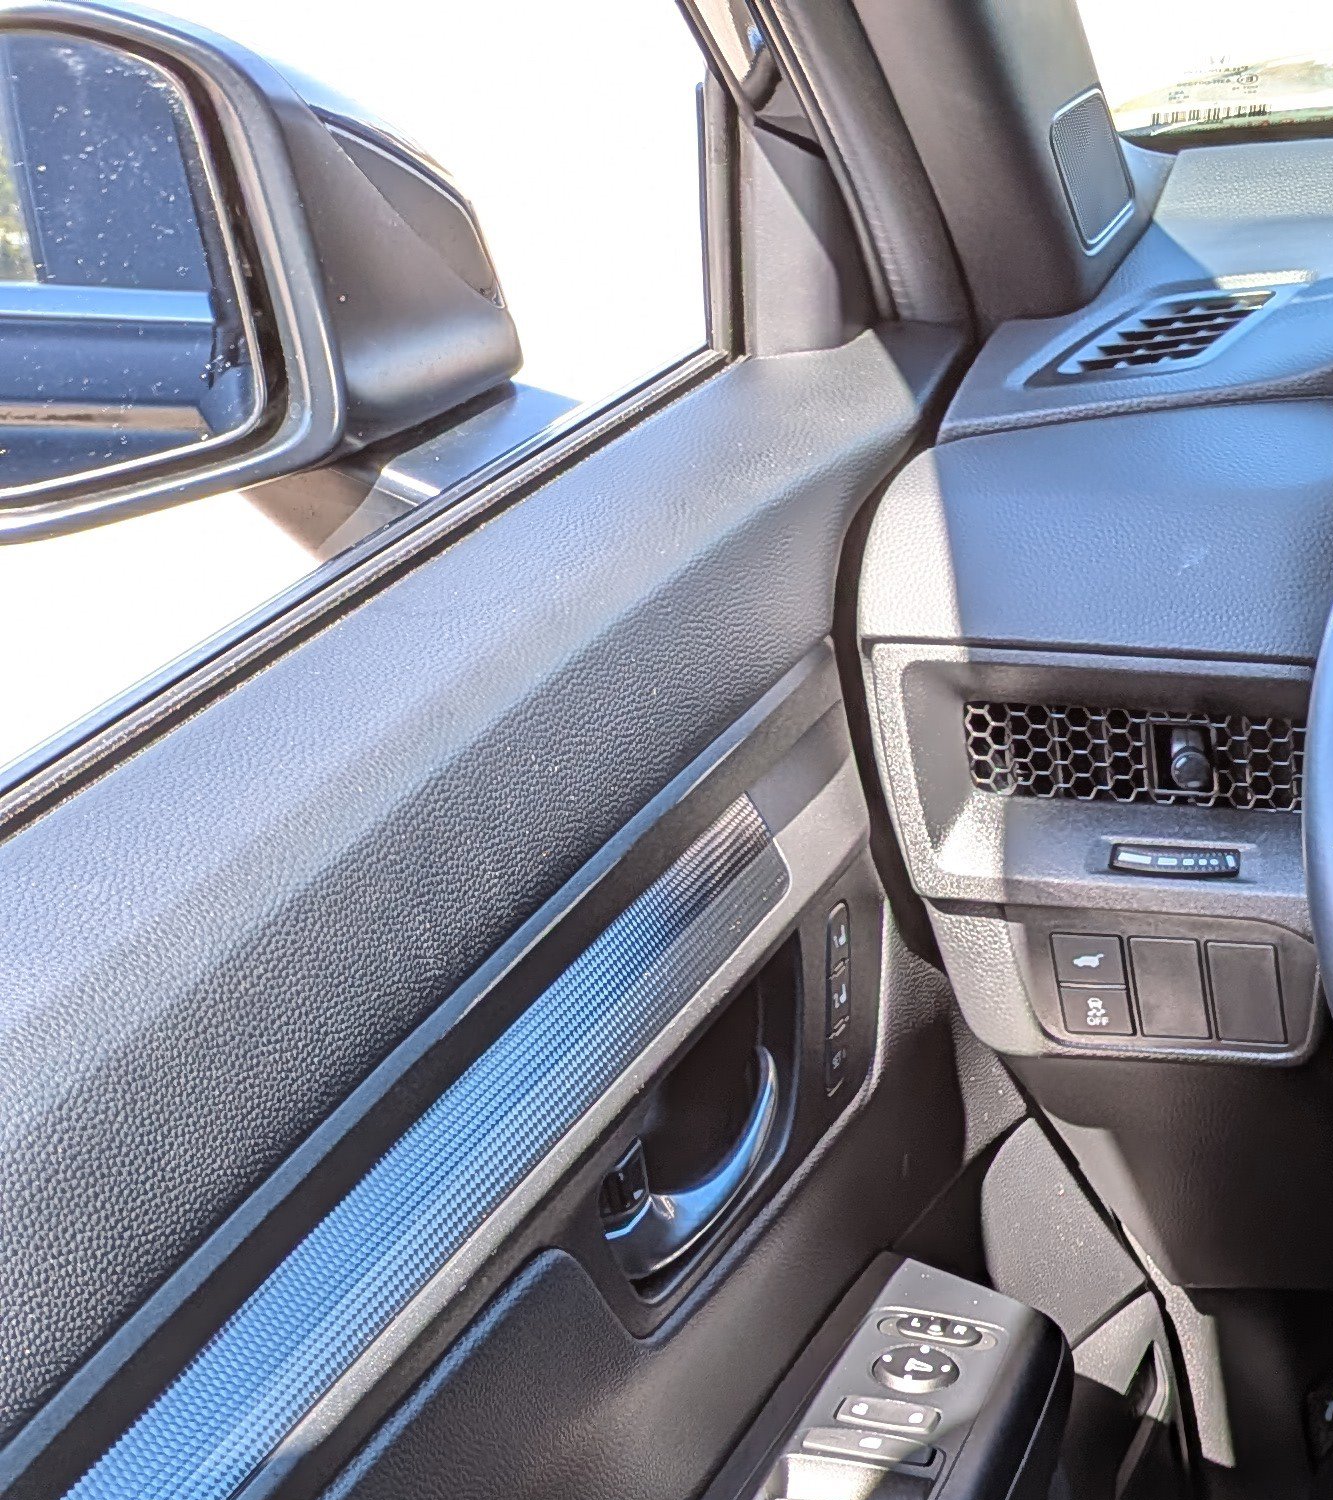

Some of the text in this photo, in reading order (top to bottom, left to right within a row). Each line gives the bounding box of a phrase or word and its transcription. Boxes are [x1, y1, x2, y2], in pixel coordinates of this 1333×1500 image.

[1086, 1016, 1109, 1026] OFF
[911, 1317, 921, 1328] L
[953, 1324, 968, 1335] R
